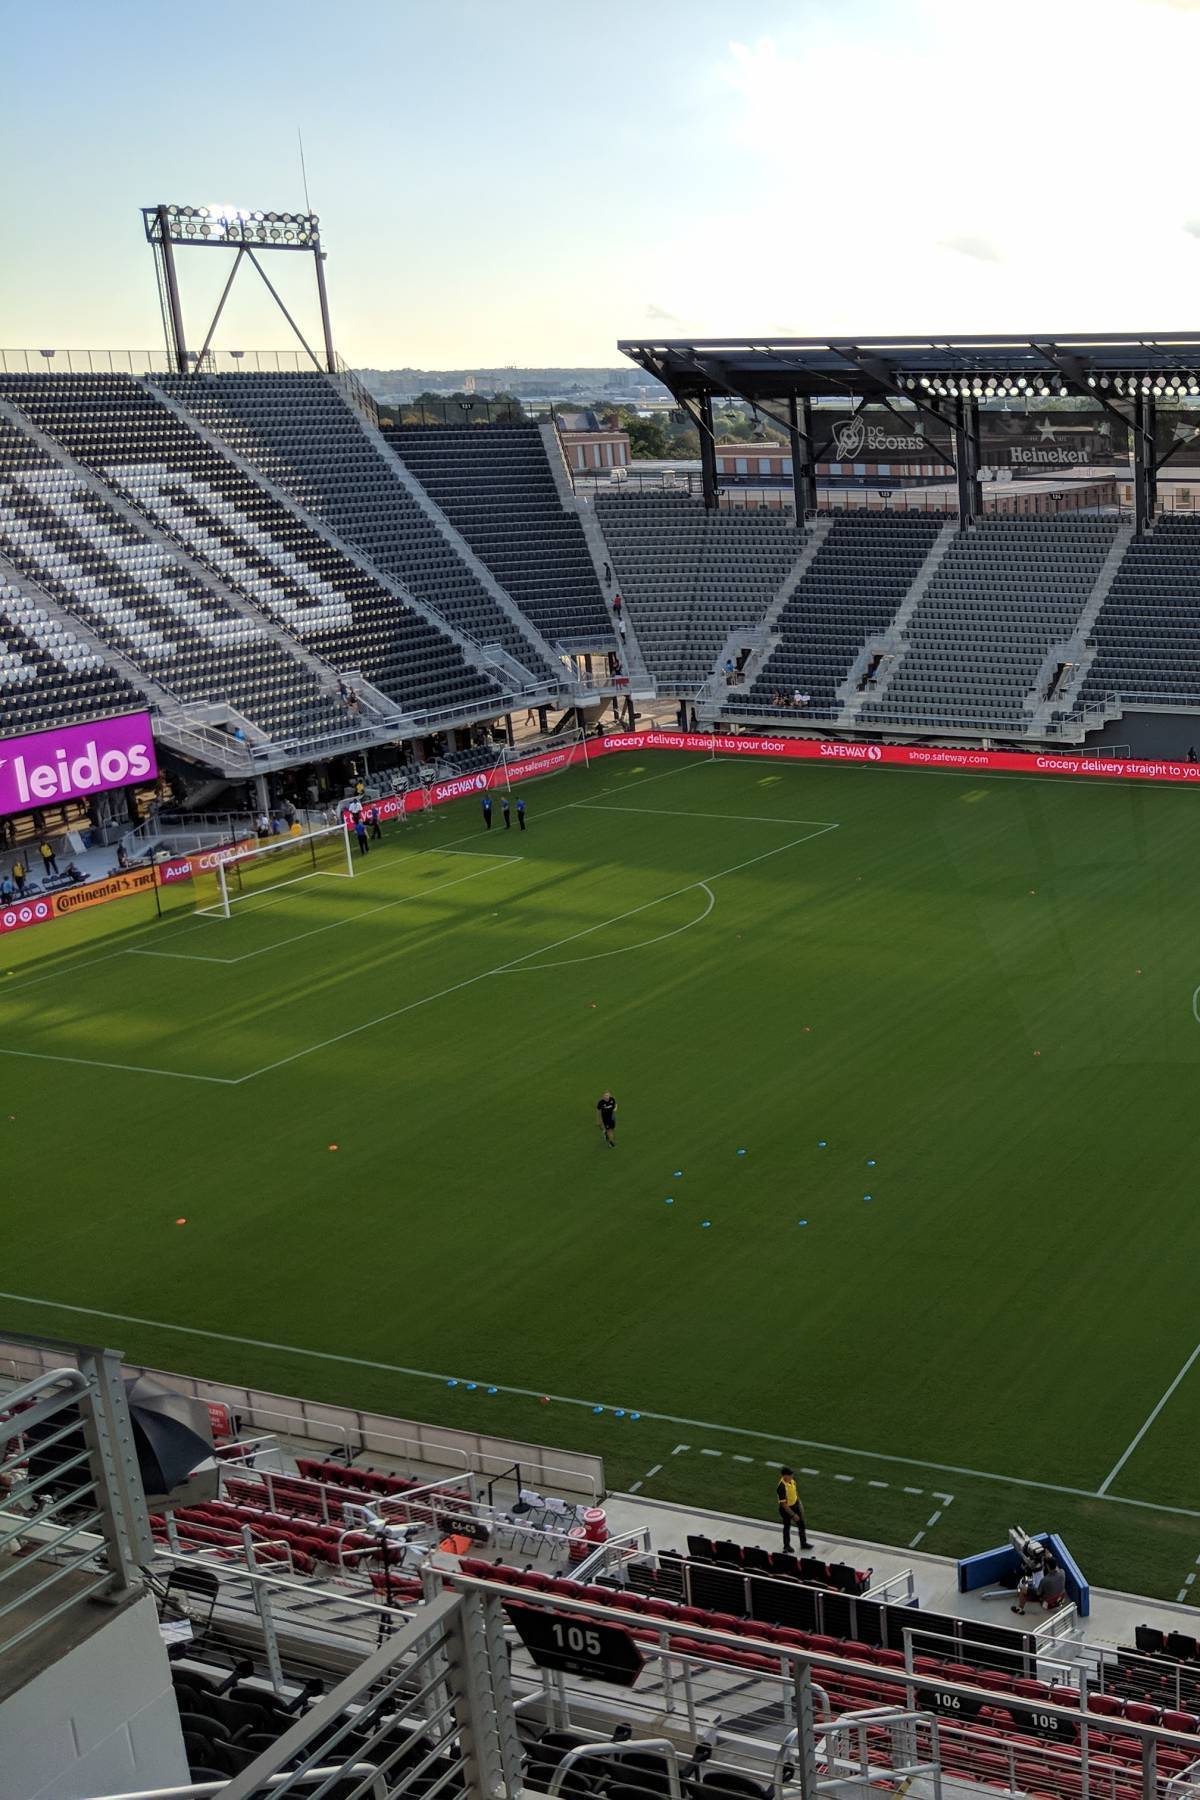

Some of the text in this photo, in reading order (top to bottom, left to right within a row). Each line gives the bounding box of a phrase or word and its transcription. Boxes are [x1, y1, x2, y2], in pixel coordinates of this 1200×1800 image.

[867, 426, 884, 437] DC
[867, 437, 924, 449] SCORES
[1011, 446, 1089, 463] Heineken
[604, 733, 785, 751] Grocery delivery straight to your door
[820, 744, 868, 758] SAFEWAY
[909, 750, 989, 764] shop.safeway.com
[14, 741, 151, 803] leidos
[1036, 757, 1079, 772] Grocery
[1081, 759, 1124, 774] delivery
[1126, 763, 1167, 776] straight
[1169, 765, 1181, 776] to
[436, 780, 476, 800] SAFEWAY
[361, 806, 382, 822] yor
[166, 861, 192, 878] Audi
[56, 879, 121, 912] Continental
[552, 1623, 602, 1655] 105
[934, 1692, 961, 1710] 106
[1031, 1713, 1058, 1730] 105
